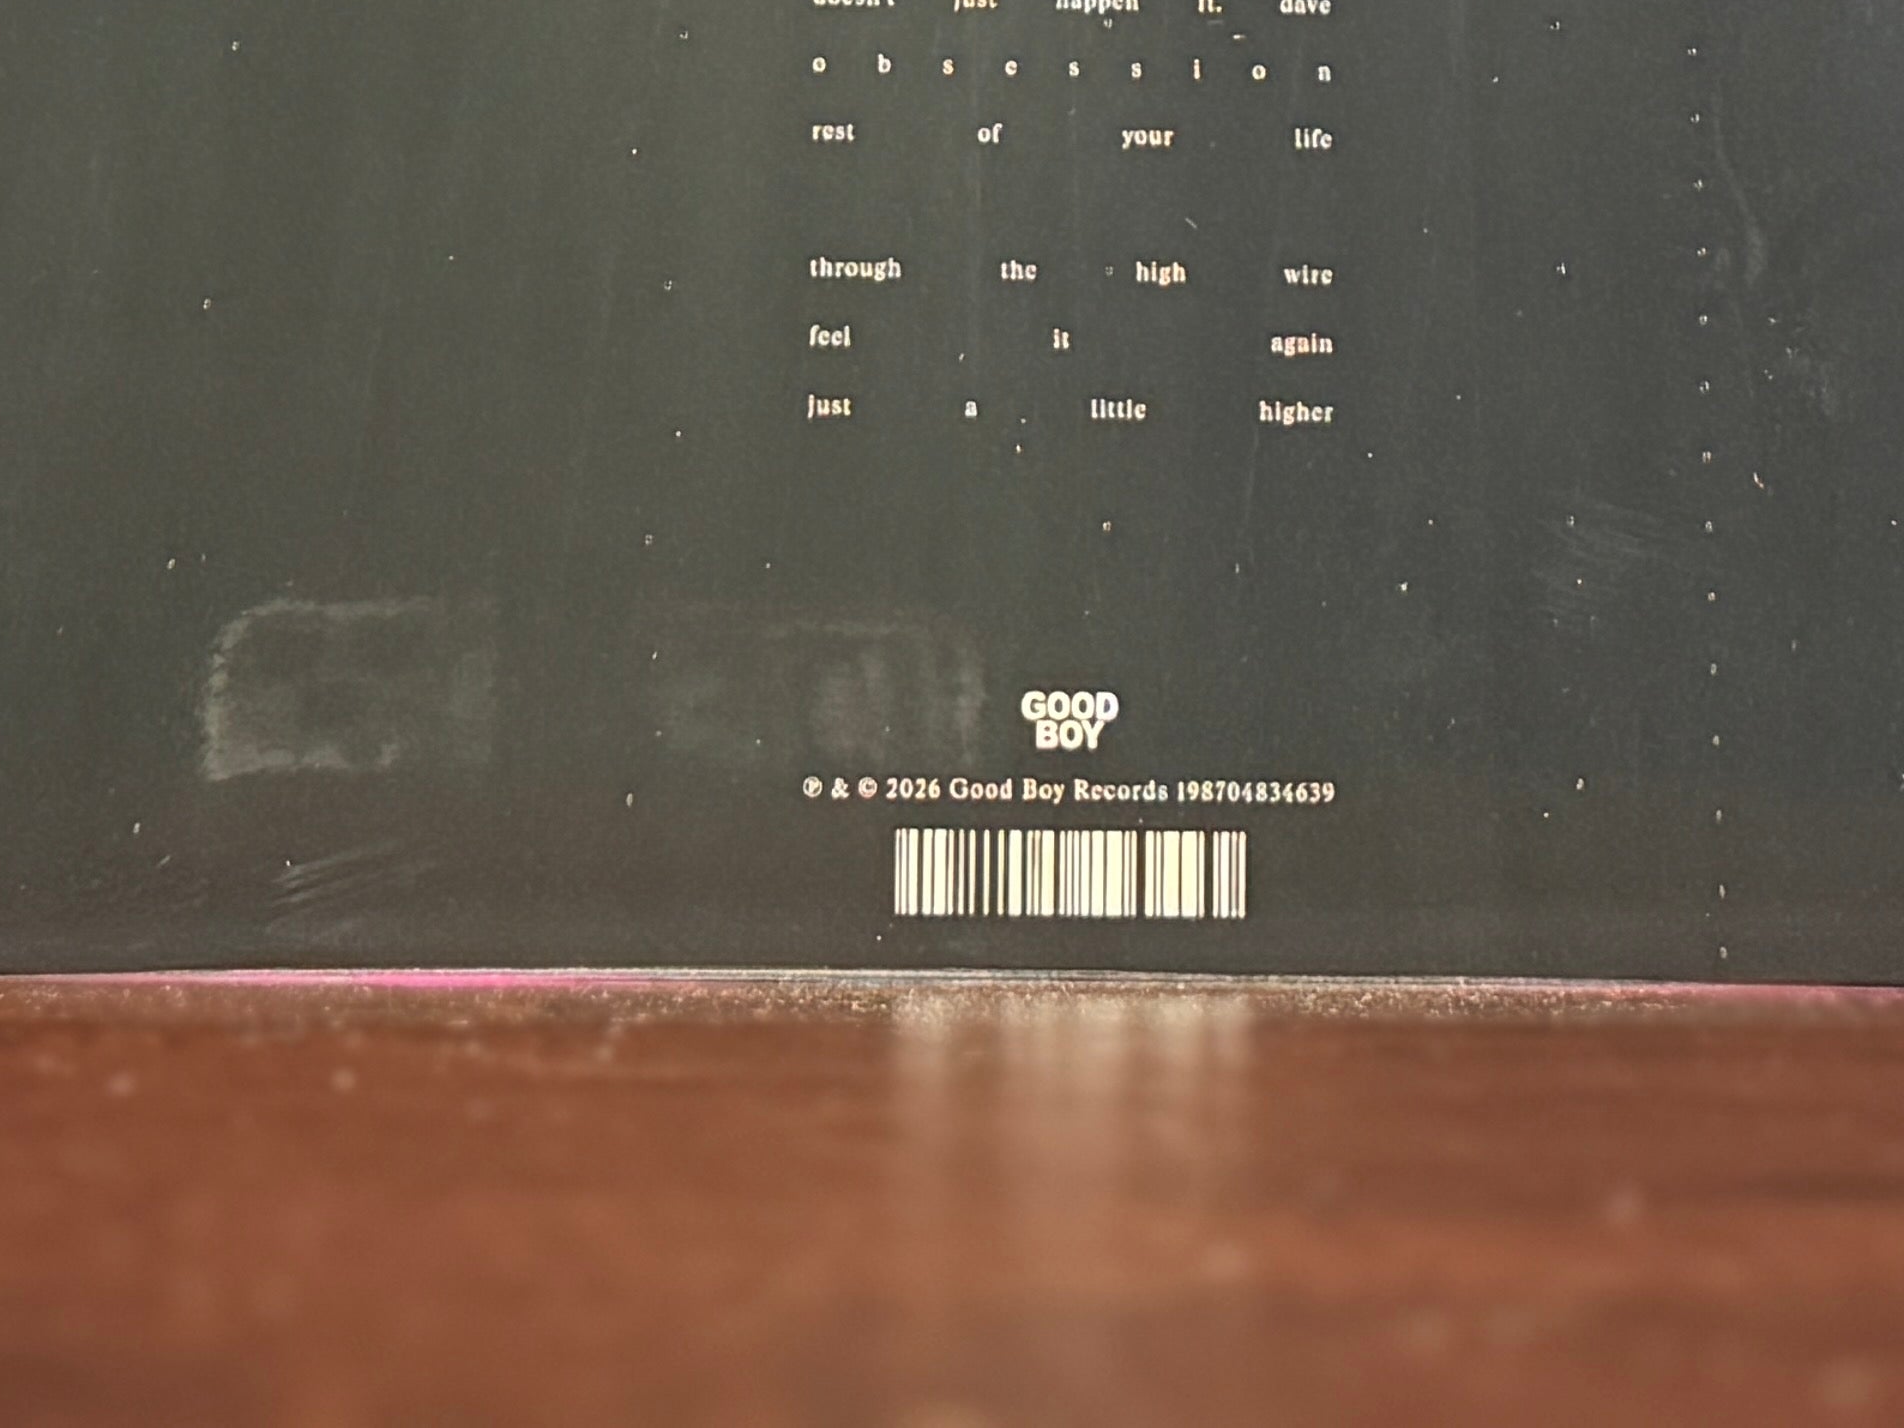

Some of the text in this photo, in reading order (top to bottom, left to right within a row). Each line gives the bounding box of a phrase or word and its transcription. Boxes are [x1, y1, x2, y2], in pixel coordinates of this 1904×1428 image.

[812, 122, 1333, 150] rest of your life
[809, 256, 1333, 287] through the high wire
[809, 324, 1334, 358] feel it again
[807, 393, 1334, 426] just a little higher
[1020, 690, 1120, 722] GOOD
[1035, 720, 1104, 751] BOY
[830, 777, 850, 800] &
[885, 777, 941, 800] 2026
[948, 777, 1013, 801] Good
[1021, 777, 1066, 805] Boy
[1073, 778, 1169, 802] Records
[1177, 780, 1335, 804] 198704834639
